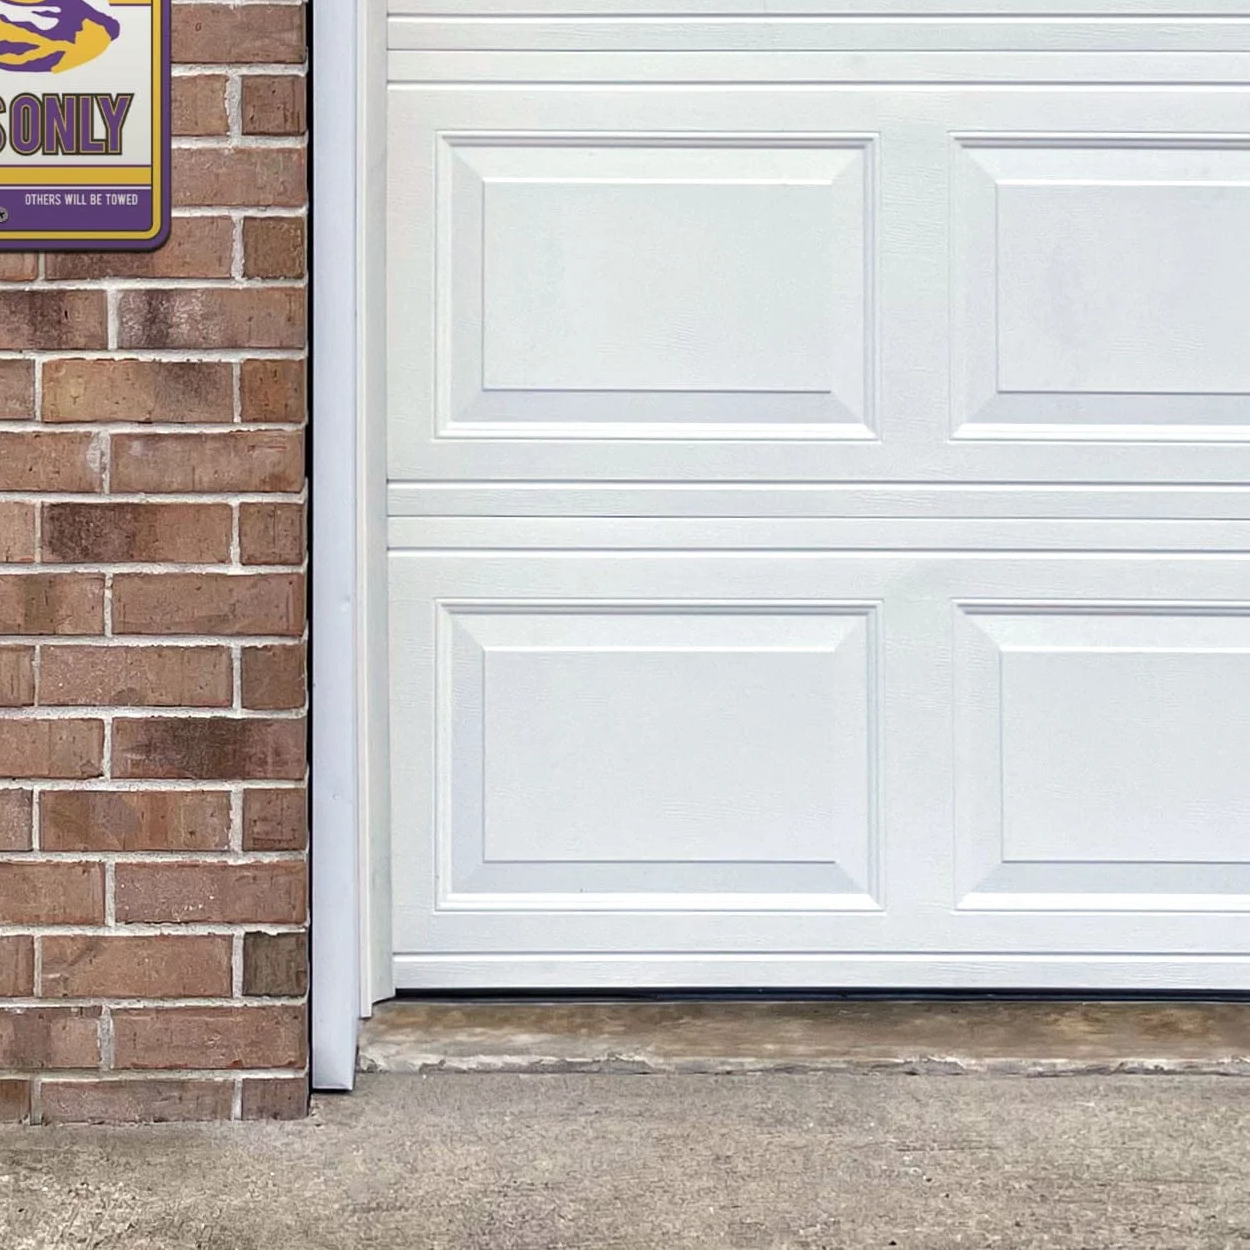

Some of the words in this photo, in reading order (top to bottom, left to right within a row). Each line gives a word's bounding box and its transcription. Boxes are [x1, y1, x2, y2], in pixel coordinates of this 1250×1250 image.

[9, 93, 135, 156] ONLY
[24, 193, 62, 206] OTHERS
[64, 193, 87, 206] WILL
[89, 193, 102, 206] BE
[105, 193, 139, 206] TOWED
